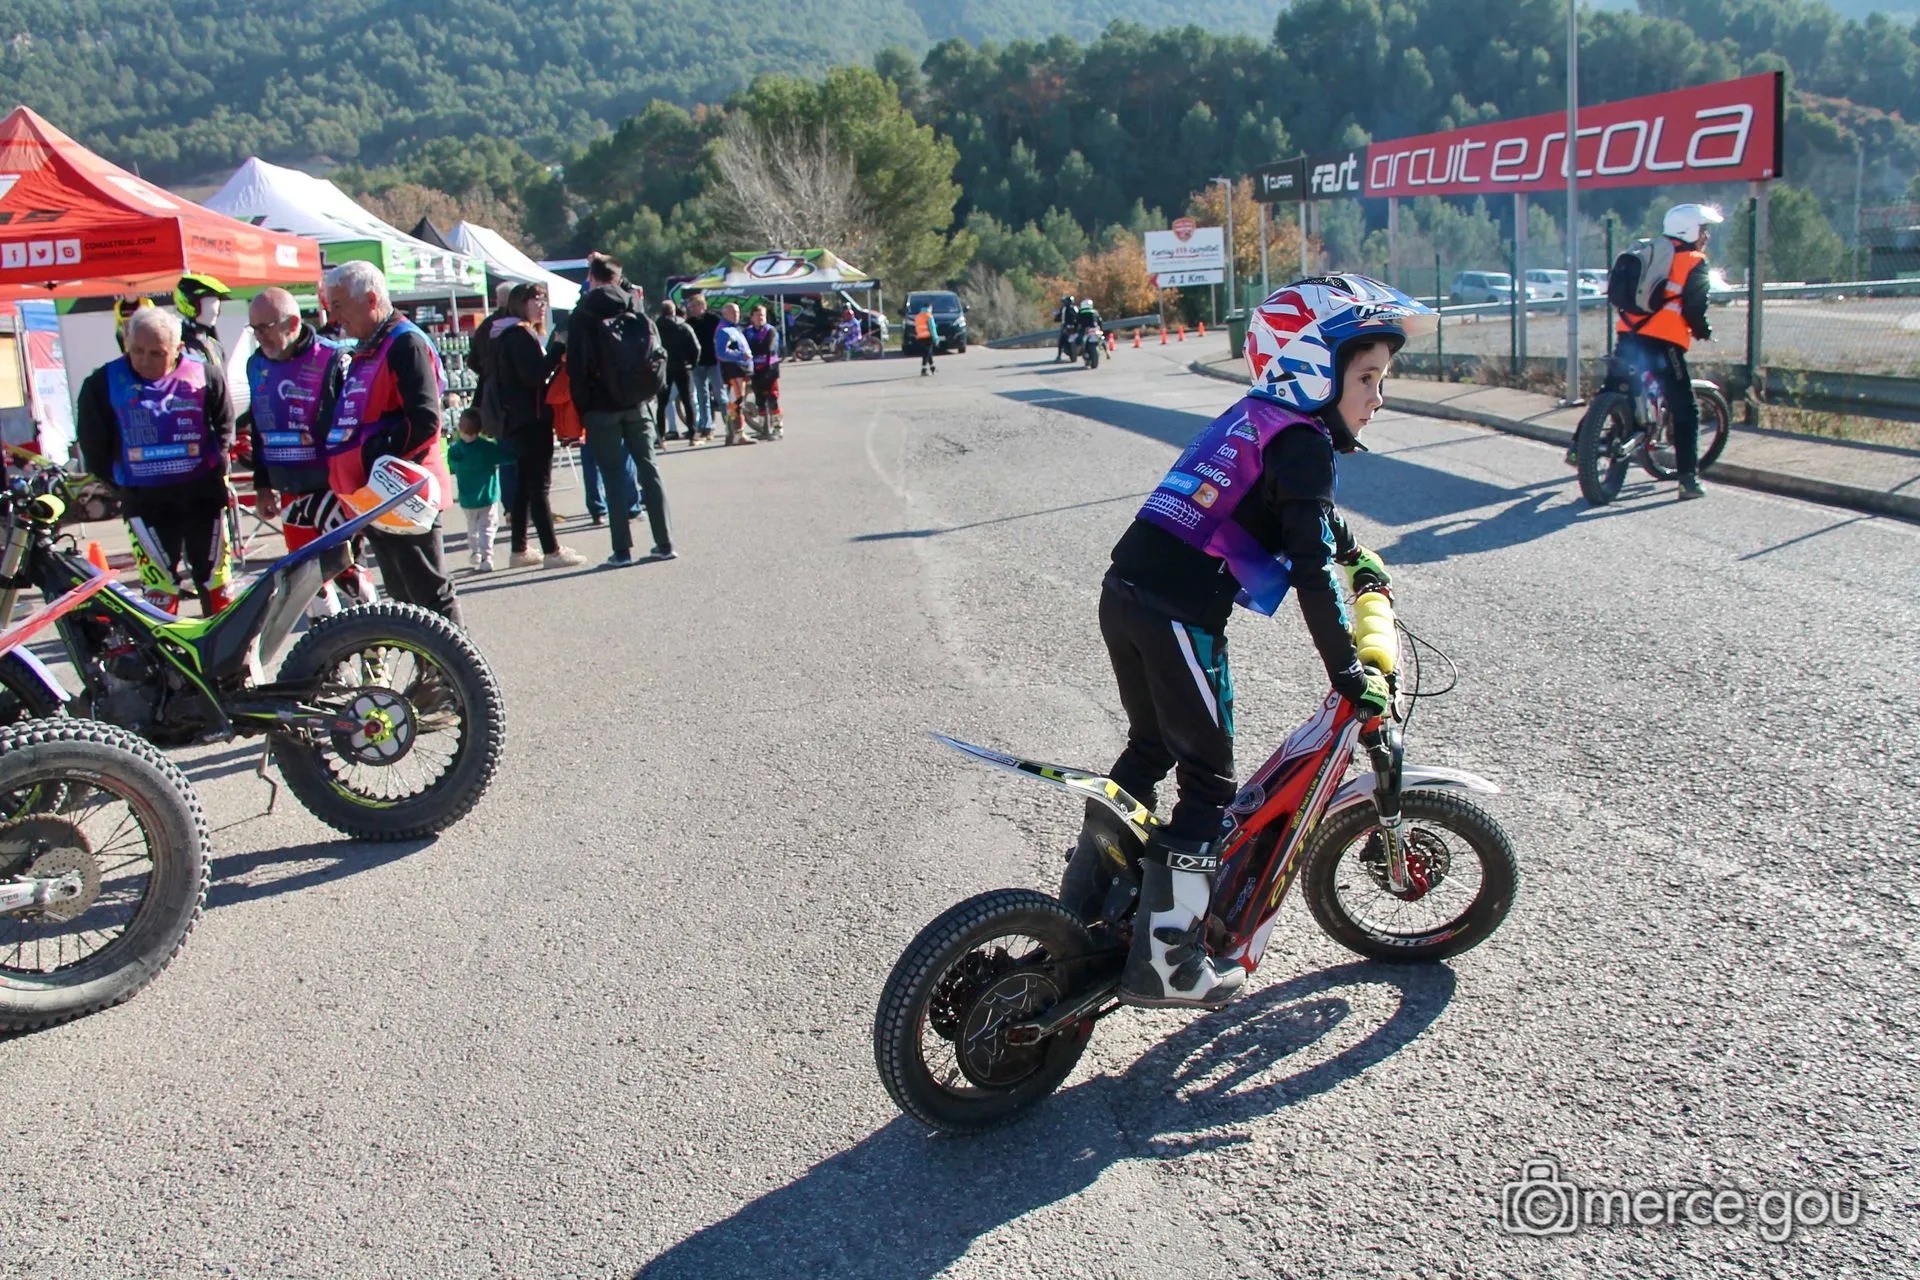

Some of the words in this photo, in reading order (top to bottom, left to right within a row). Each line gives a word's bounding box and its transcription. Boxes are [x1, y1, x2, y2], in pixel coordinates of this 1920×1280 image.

[1311, 153, 1360, 194] fast
[1370, 138, 1486, 190] circuit
[1269, 174, 1294, 189] CUPRA
[1168, 275, 1176, 284] A
[1180, 274, 1185, 284] 1
[1217, 443, 1238, 460] fcm
[1193, 462, 1232, 488] TrialGo
